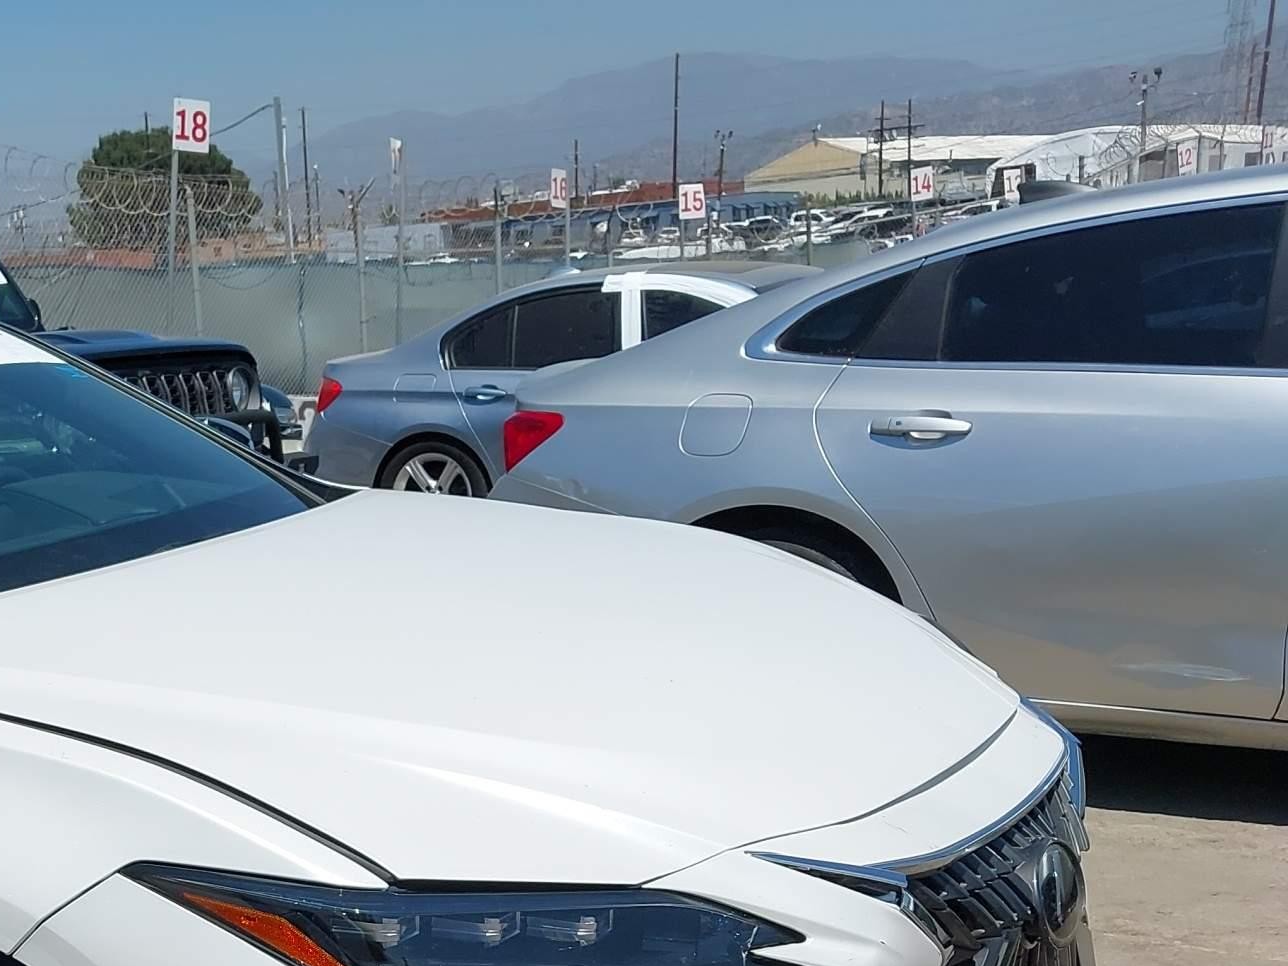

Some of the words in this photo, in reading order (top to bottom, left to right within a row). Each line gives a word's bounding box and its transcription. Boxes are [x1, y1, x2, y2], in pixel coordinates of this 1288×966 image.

[175, 109, 207, 142] 18
[1178, 148, 1193, 169] 12
[912, 173, 932, 195] 14
[681, 191, 704, 212] 15
